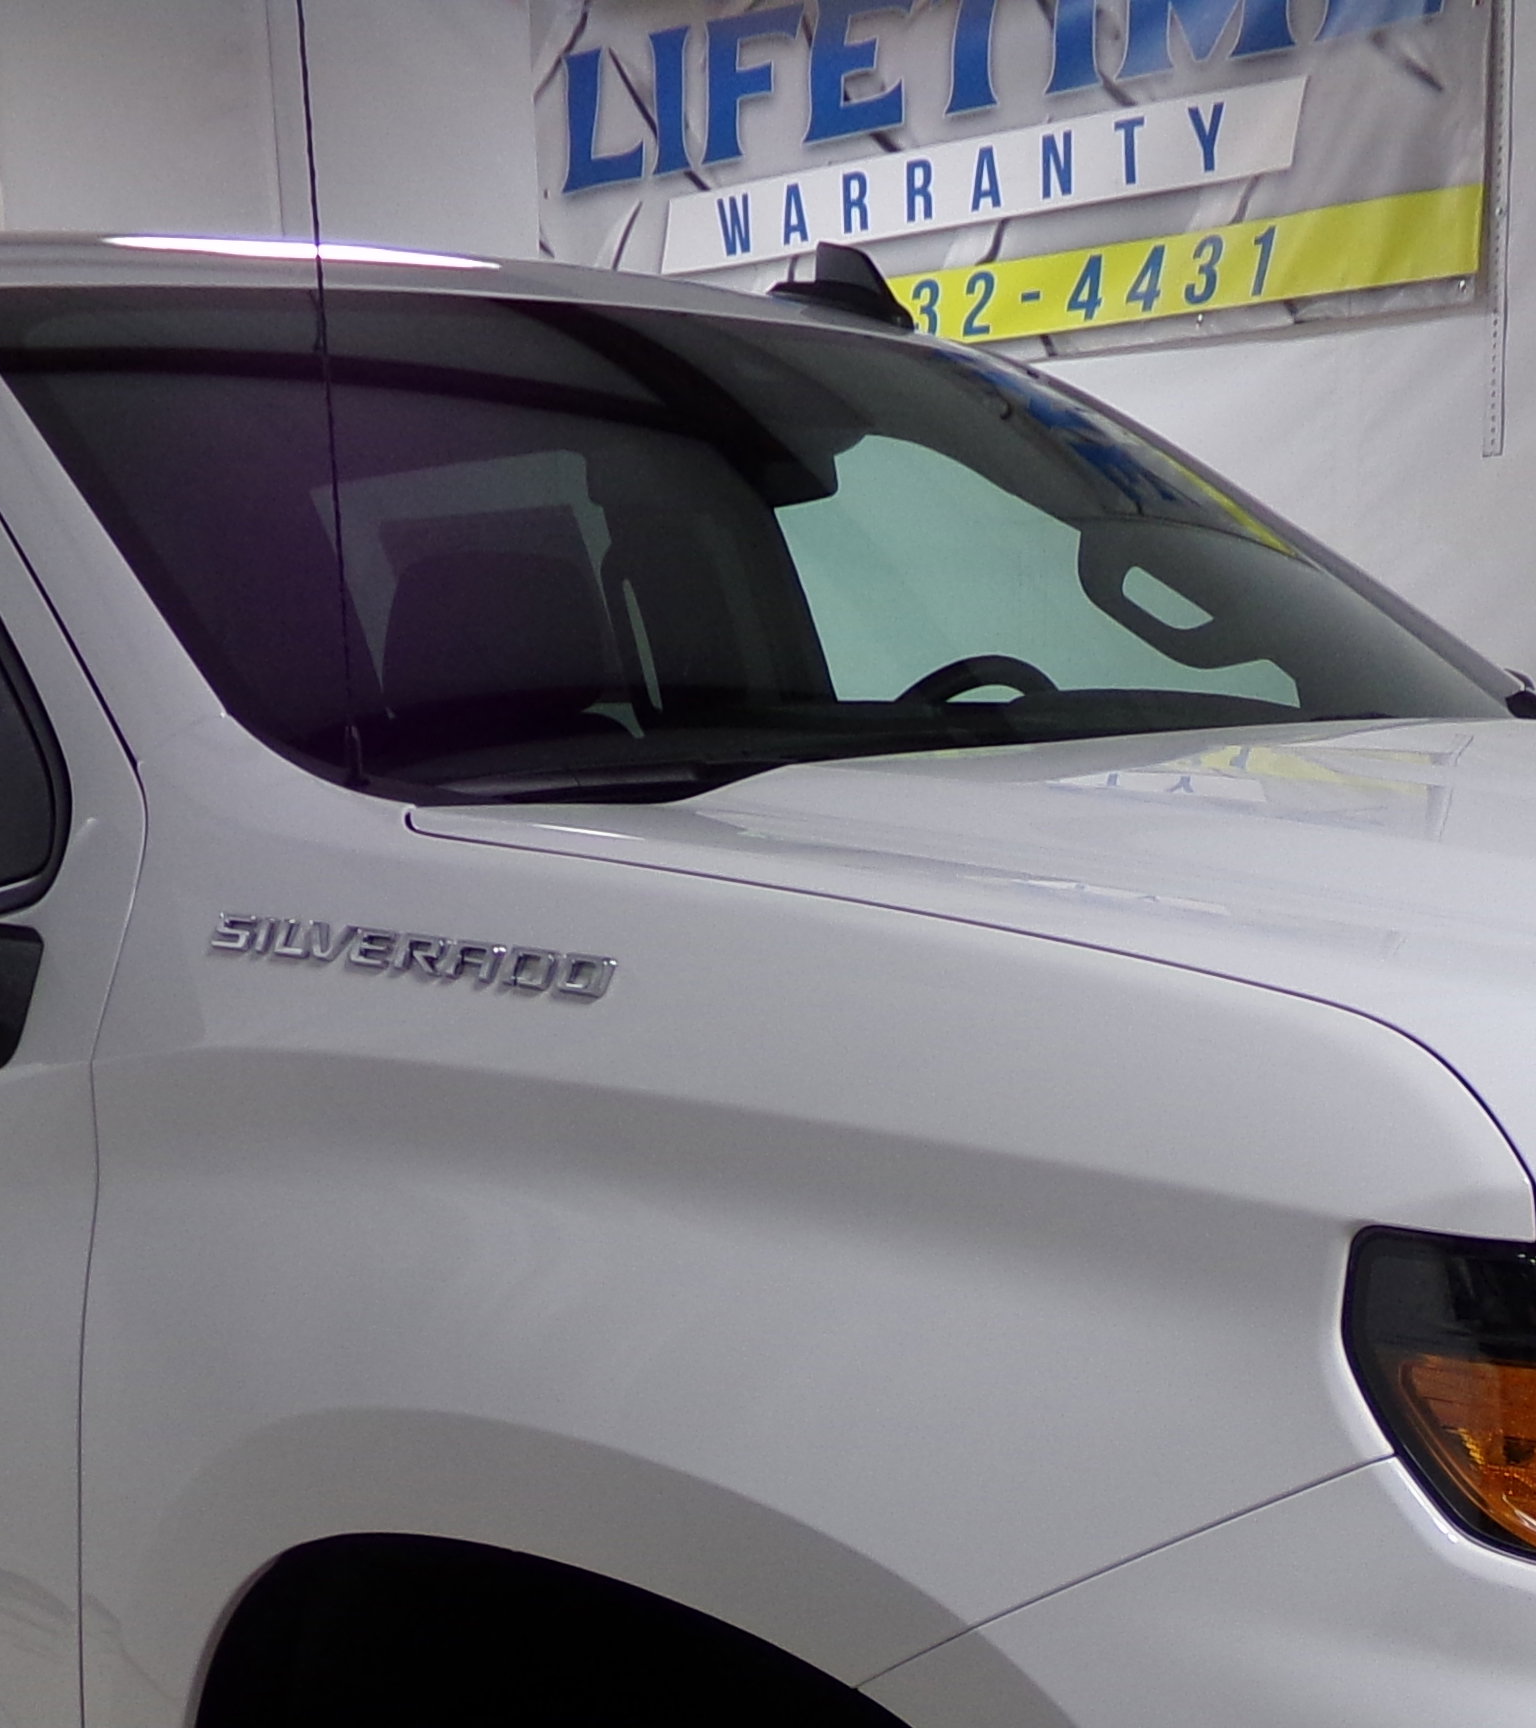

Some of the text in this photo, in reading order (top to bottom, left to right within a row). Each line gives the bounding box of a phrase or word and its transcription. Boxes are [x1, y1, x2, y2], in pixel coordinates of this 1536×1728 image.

[562, 0, 1446, 194] LIFETIM
[716, 101, 1225, 257] WARRANTY
[910, 225, 1278, 338] 32-4431
[209, 910, 619, 1000] SILVERADO
